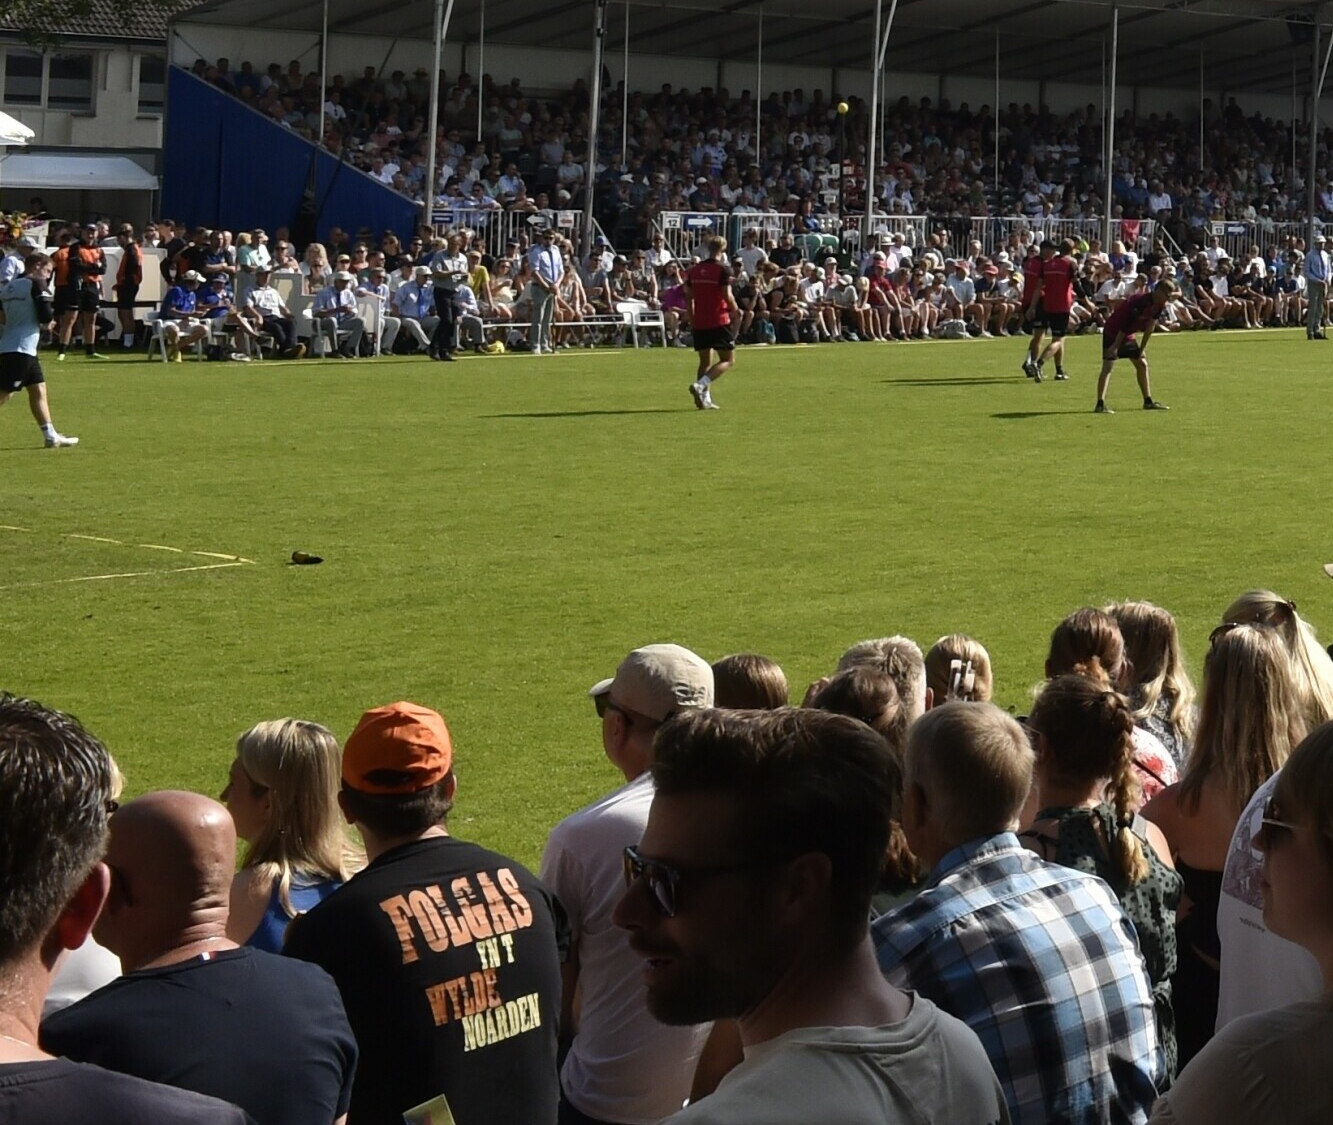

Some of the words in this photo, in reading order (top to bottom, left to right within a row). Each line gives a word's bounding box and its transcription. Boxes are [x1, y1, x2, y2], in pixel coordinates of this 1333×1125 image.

[380, 868, 533, 965] FOLGAS
[476, 937, 501, 970] YN
[425, 968, 502, 1026] WYLDE
[461, 992, 541, 1052] NOARDEN
